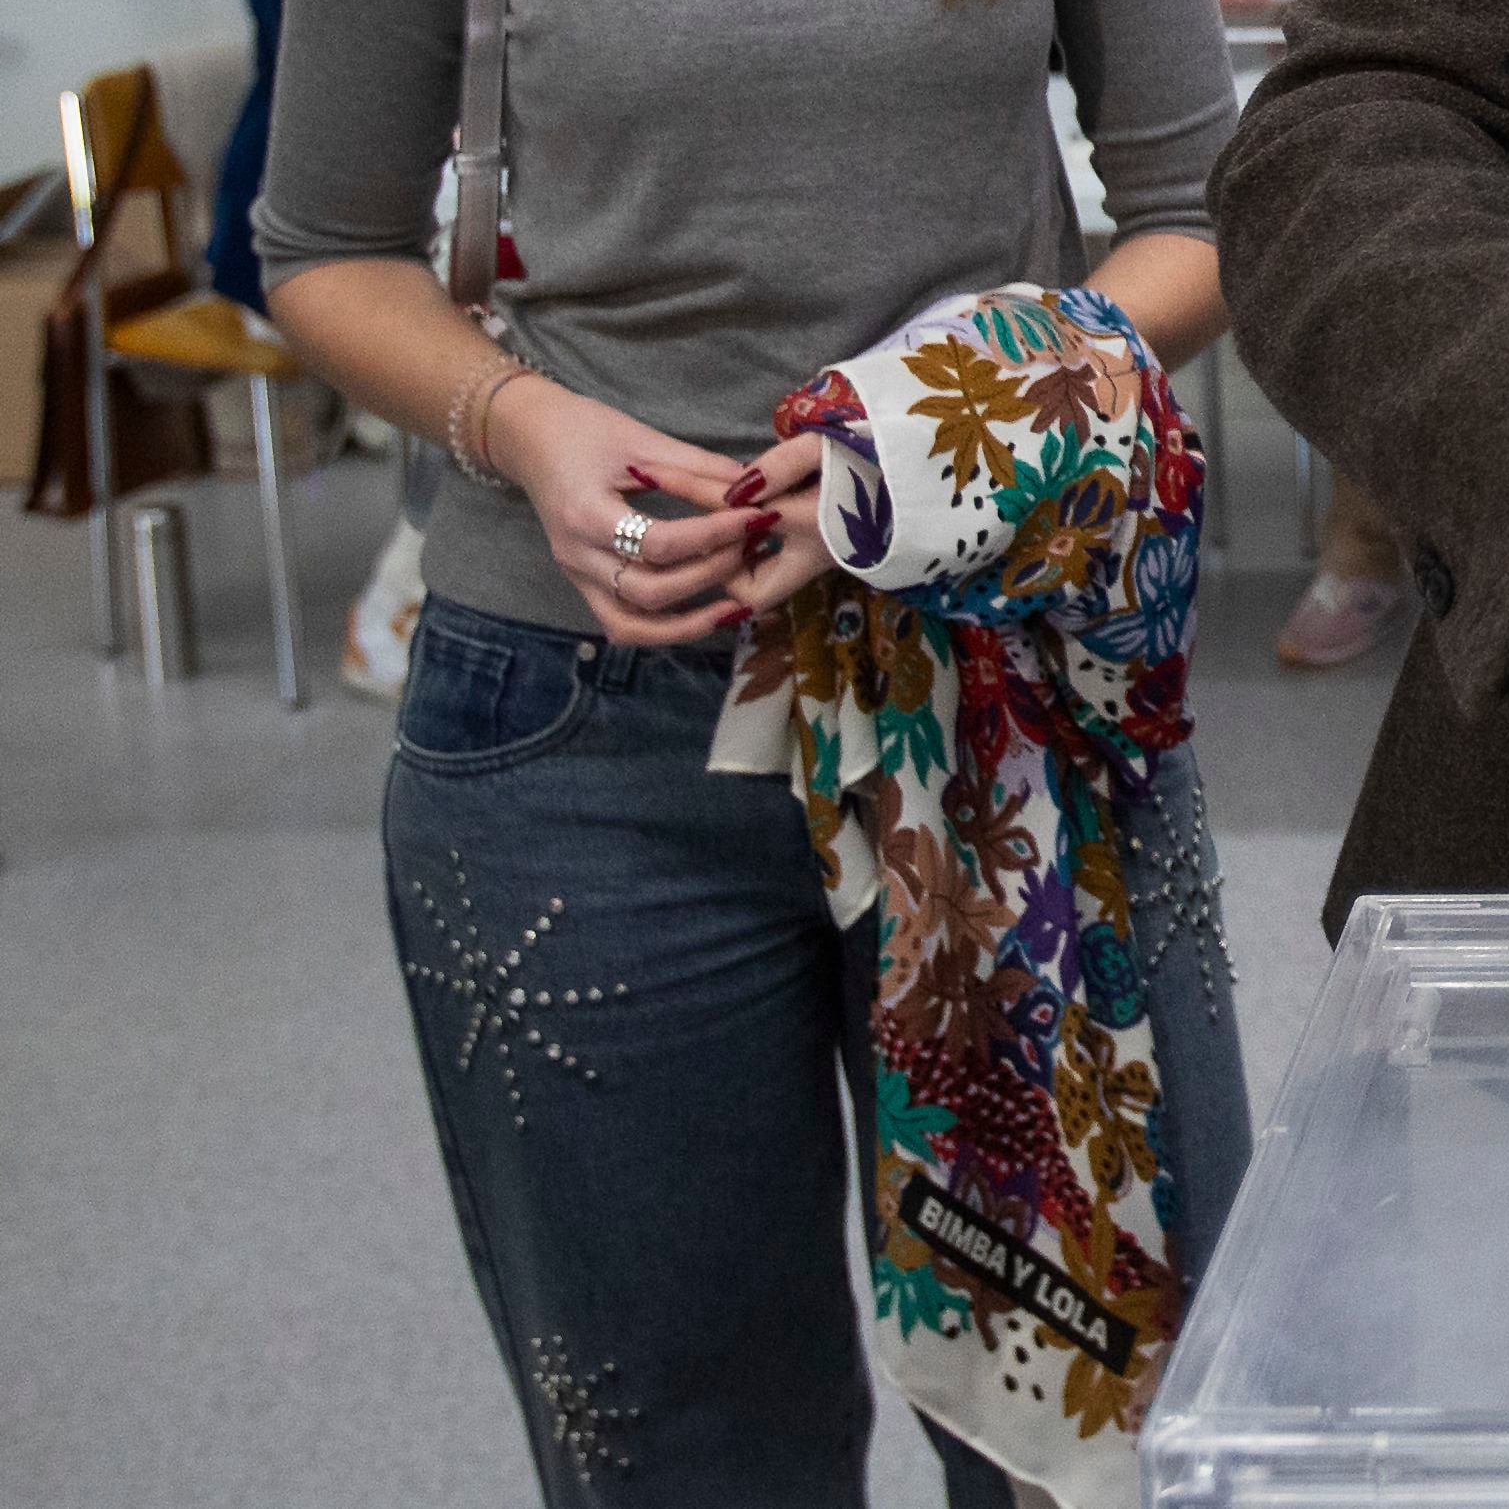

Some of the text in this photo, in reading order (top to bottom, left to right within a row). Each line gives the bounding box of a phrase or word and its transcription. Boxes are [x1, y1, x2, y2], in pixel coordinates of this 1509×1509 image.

[917, 1195, 1109, 1352] BIMBA Y LOLA
